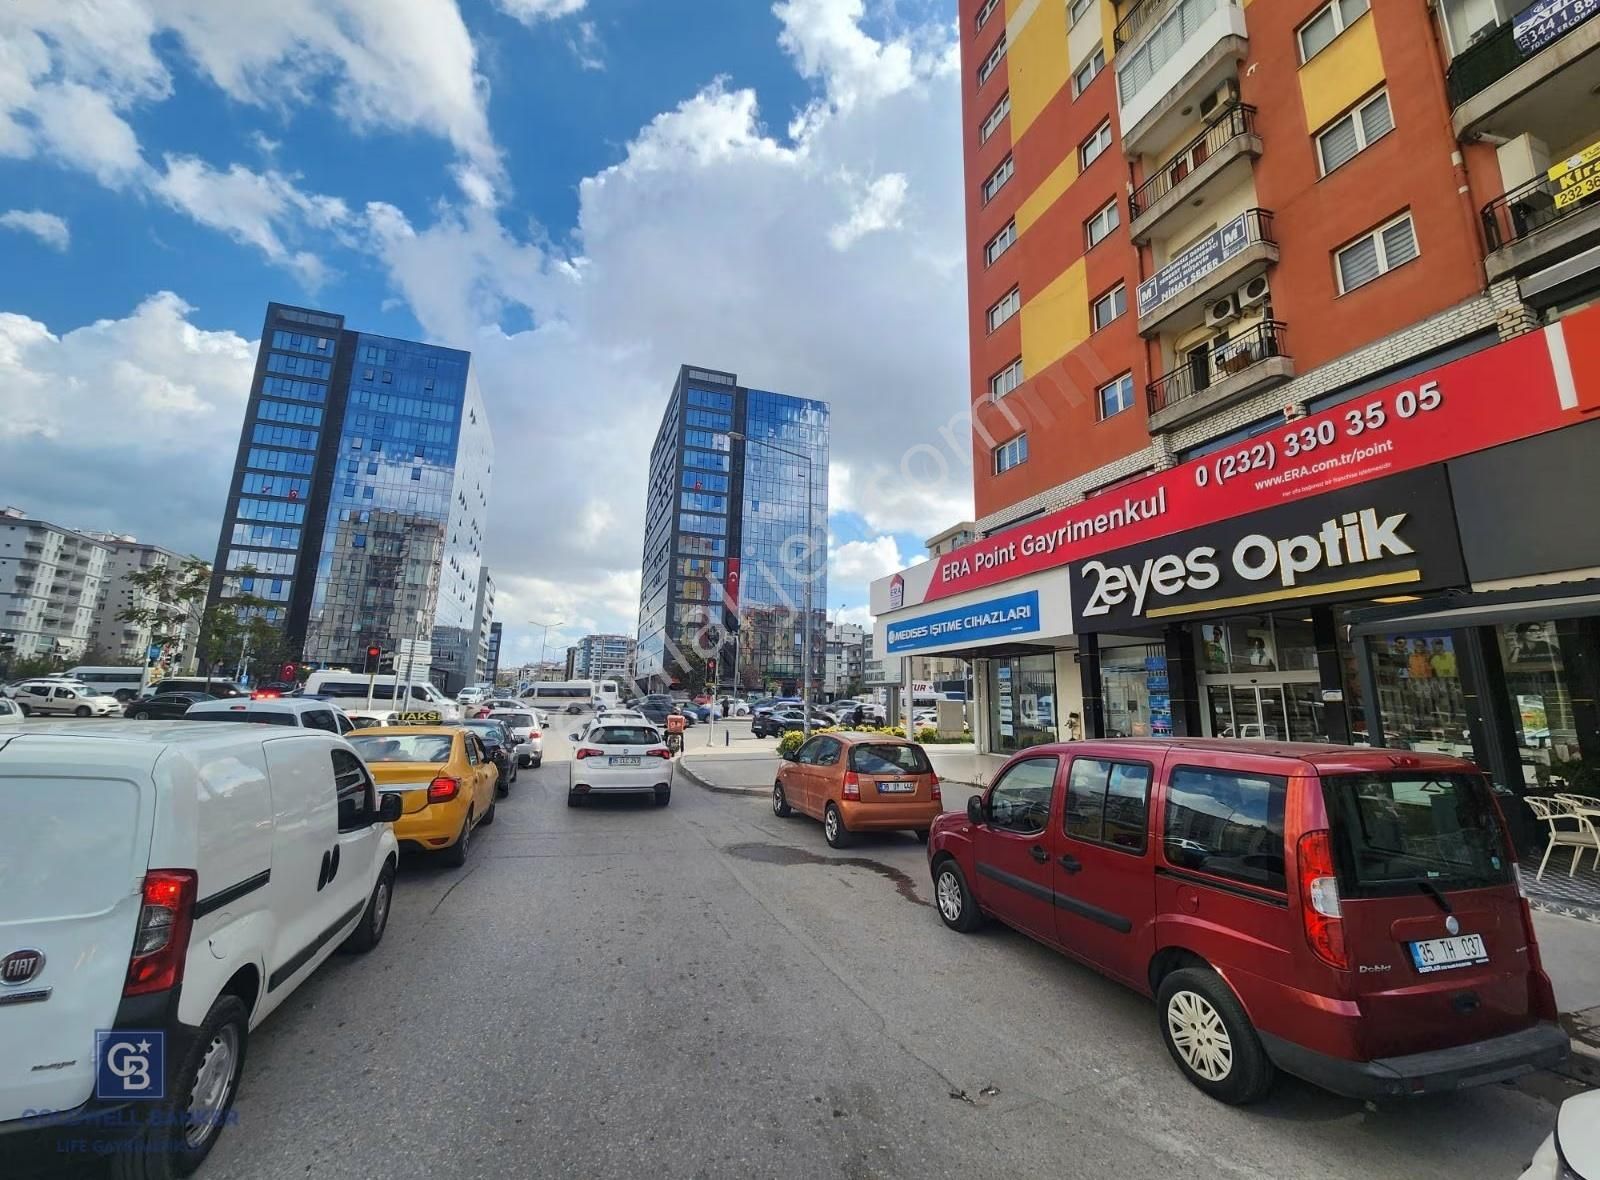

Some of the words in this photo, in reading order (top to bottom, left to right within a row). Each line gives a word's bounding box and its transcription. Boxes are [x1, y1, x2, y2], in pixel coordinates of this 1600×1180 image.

[1529, 18, 1555, 42] 344
[1561, 10, 1568, 21] 1
[1531, 32, 1556, 50] TOLGA
[1560, 186, 1583, 205] 232
[1195, 465, 1208, 487] 0
[1214, 441, 1277, 486] (232)
[1283, 420, 1336, 457] 330
[1345, 401, 1386, 436] 35
[1395, 380, 1442, 418] 05
[1255, 439, 1393, 491] www.ERA.com.tr/point
[942, 559, 971, 583] ERA
[975, 542, 1017, 572] Point
[1021, 486, 1167, 554] Gayrimenkul
[1082, 546, 1220, 617] 2eyes
[1232, 508, 1415, 587] Optik
[1419, 943, 1434, 962] 35
[1440, 941, 1456, 959] TH
[1461, 937, 1481, 956] 037
[7, 957, 36, 977] FIAT
